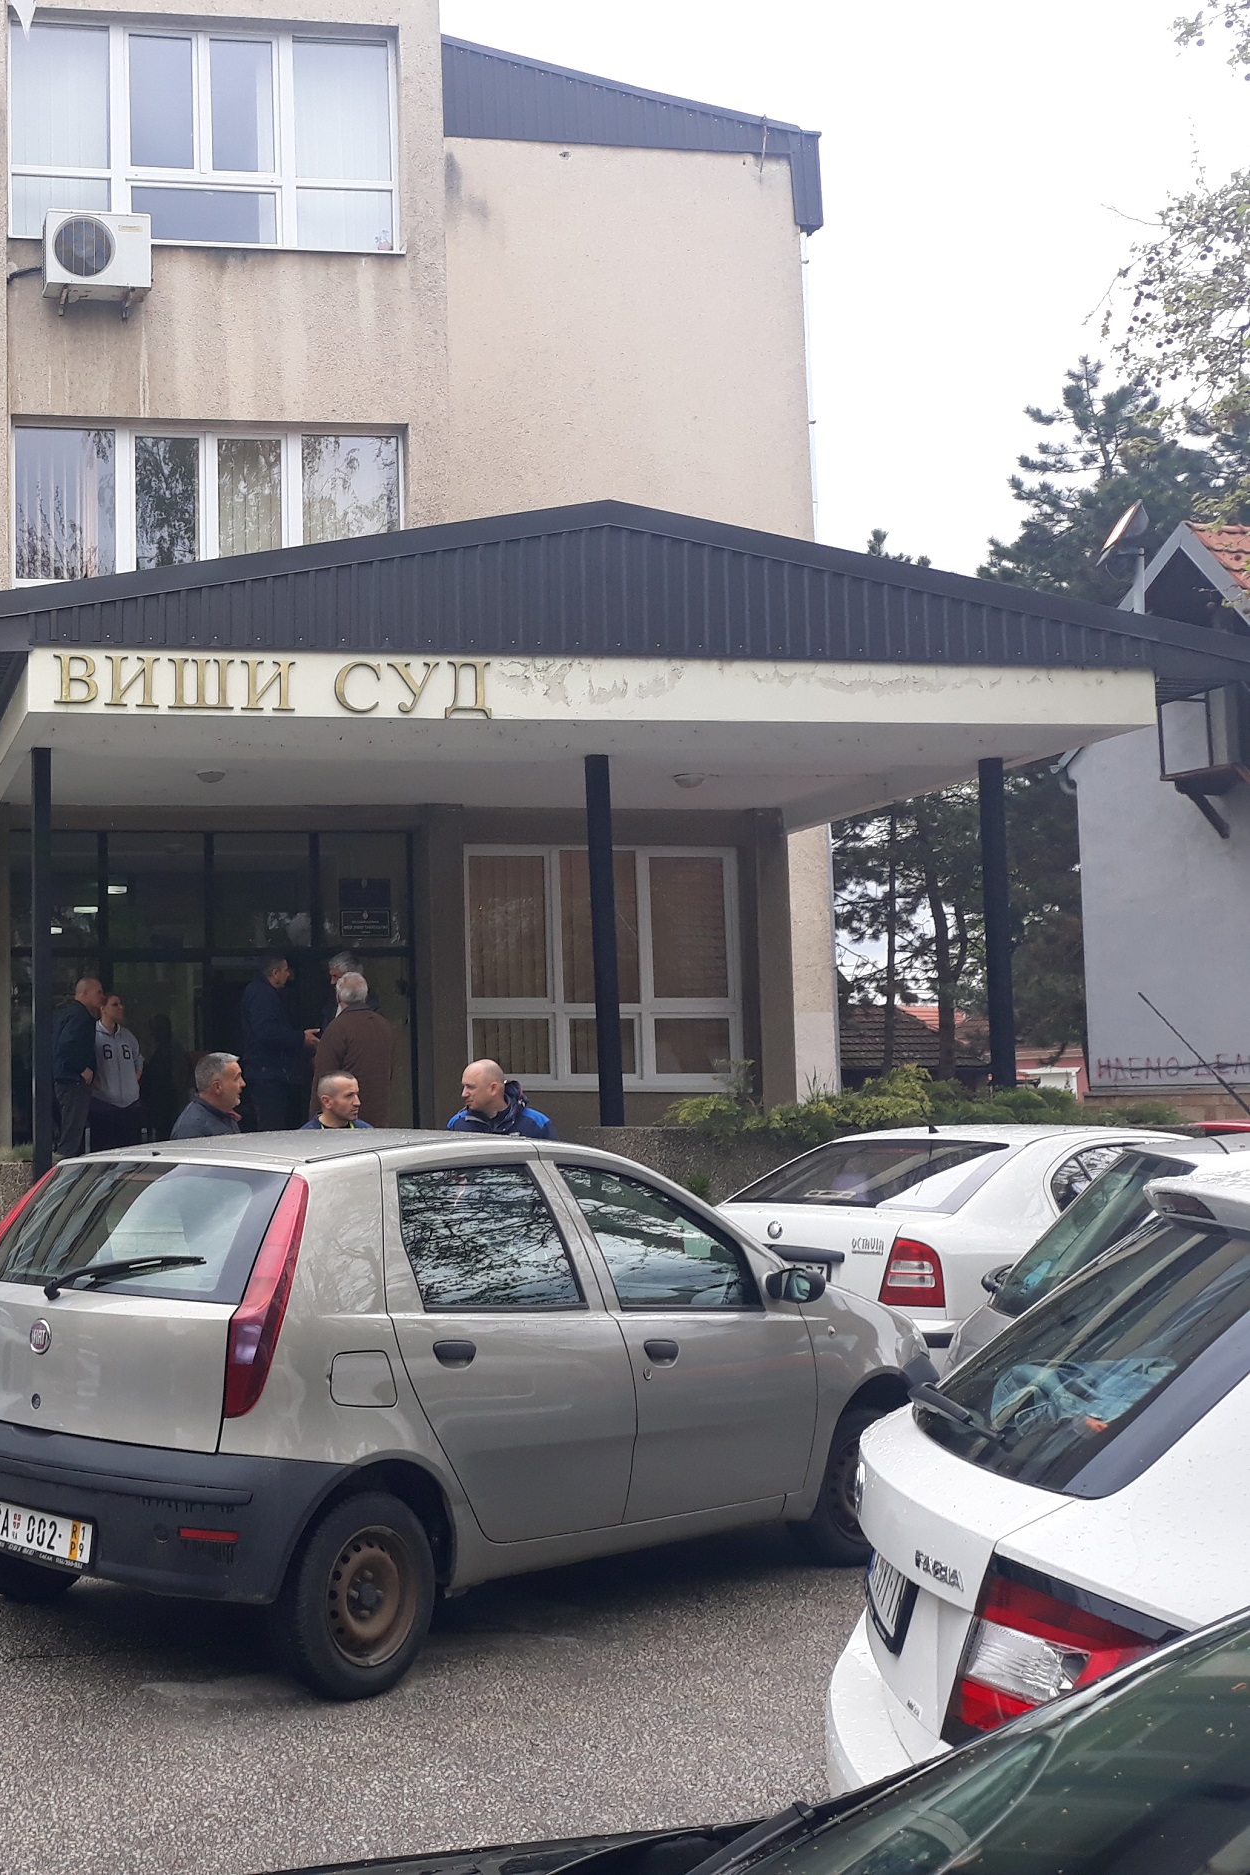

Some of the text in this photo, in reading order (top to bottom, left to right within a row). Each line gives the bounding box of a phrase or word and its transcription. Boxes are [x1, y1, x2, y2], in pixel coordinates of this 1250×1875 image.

[53, 653, 492, 719] ВИШИ СУД
[103, 1043, 131, 1059] 6 6
[851, 1237, 884, 1251] OCTAVIA
[914, 1549, 965, 1592] FABIA
